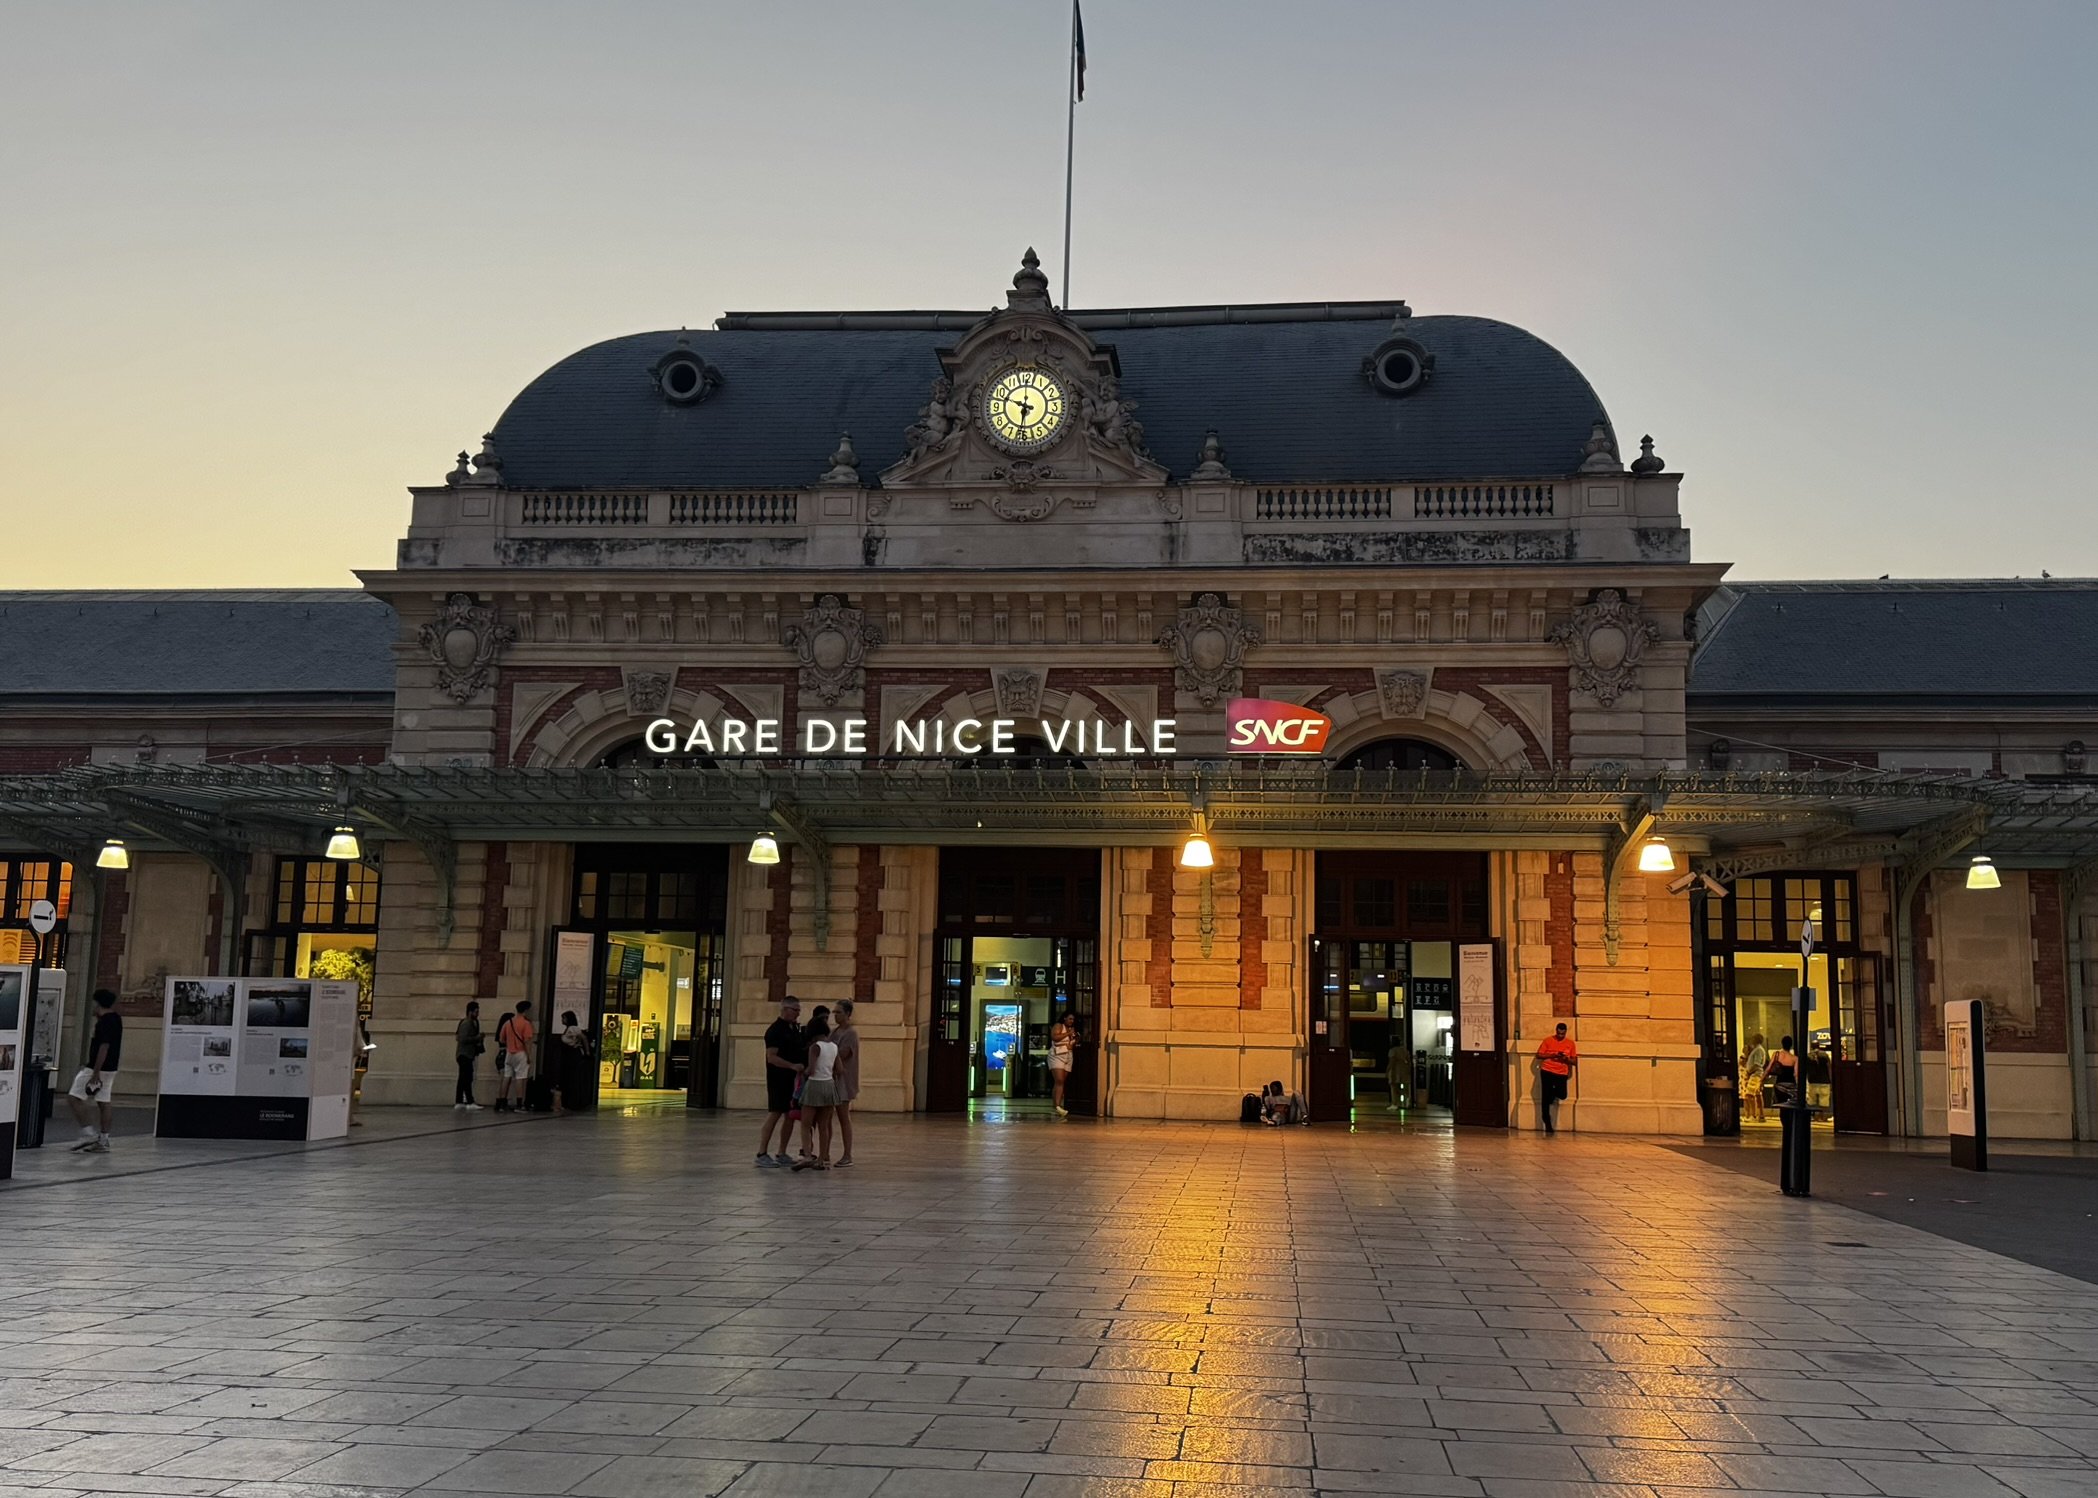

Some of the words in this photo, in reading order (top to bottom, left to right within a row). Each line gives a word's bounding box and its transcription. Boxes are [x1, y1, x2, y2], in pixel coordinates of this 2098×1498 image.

[1008, 378, 1016, 387] 11
[1022, 373, 1032, 384] 12
[1039, 378, 1043, 387] 1
[996, 387, 1005, 398] 10
[1048, 387, 1055, 398] 2
[993, 402, 1000, 412] 9
[1051, 402, 1058, 412] 3
[996, 416, 1003, 427] 8
[1047, 417, 1054, 426] 4
[1007, 426, 1014, 437] 7
[1036, 426, 1043, 437] 5
[645, 719, 778, 753] GARE
[806, 719, 867, 753] DE
[895, 719, 1015, 753] NICE
[1041, 719, 1177, 753] VILLE
[1230, 719, 1324, 745] SNCF
